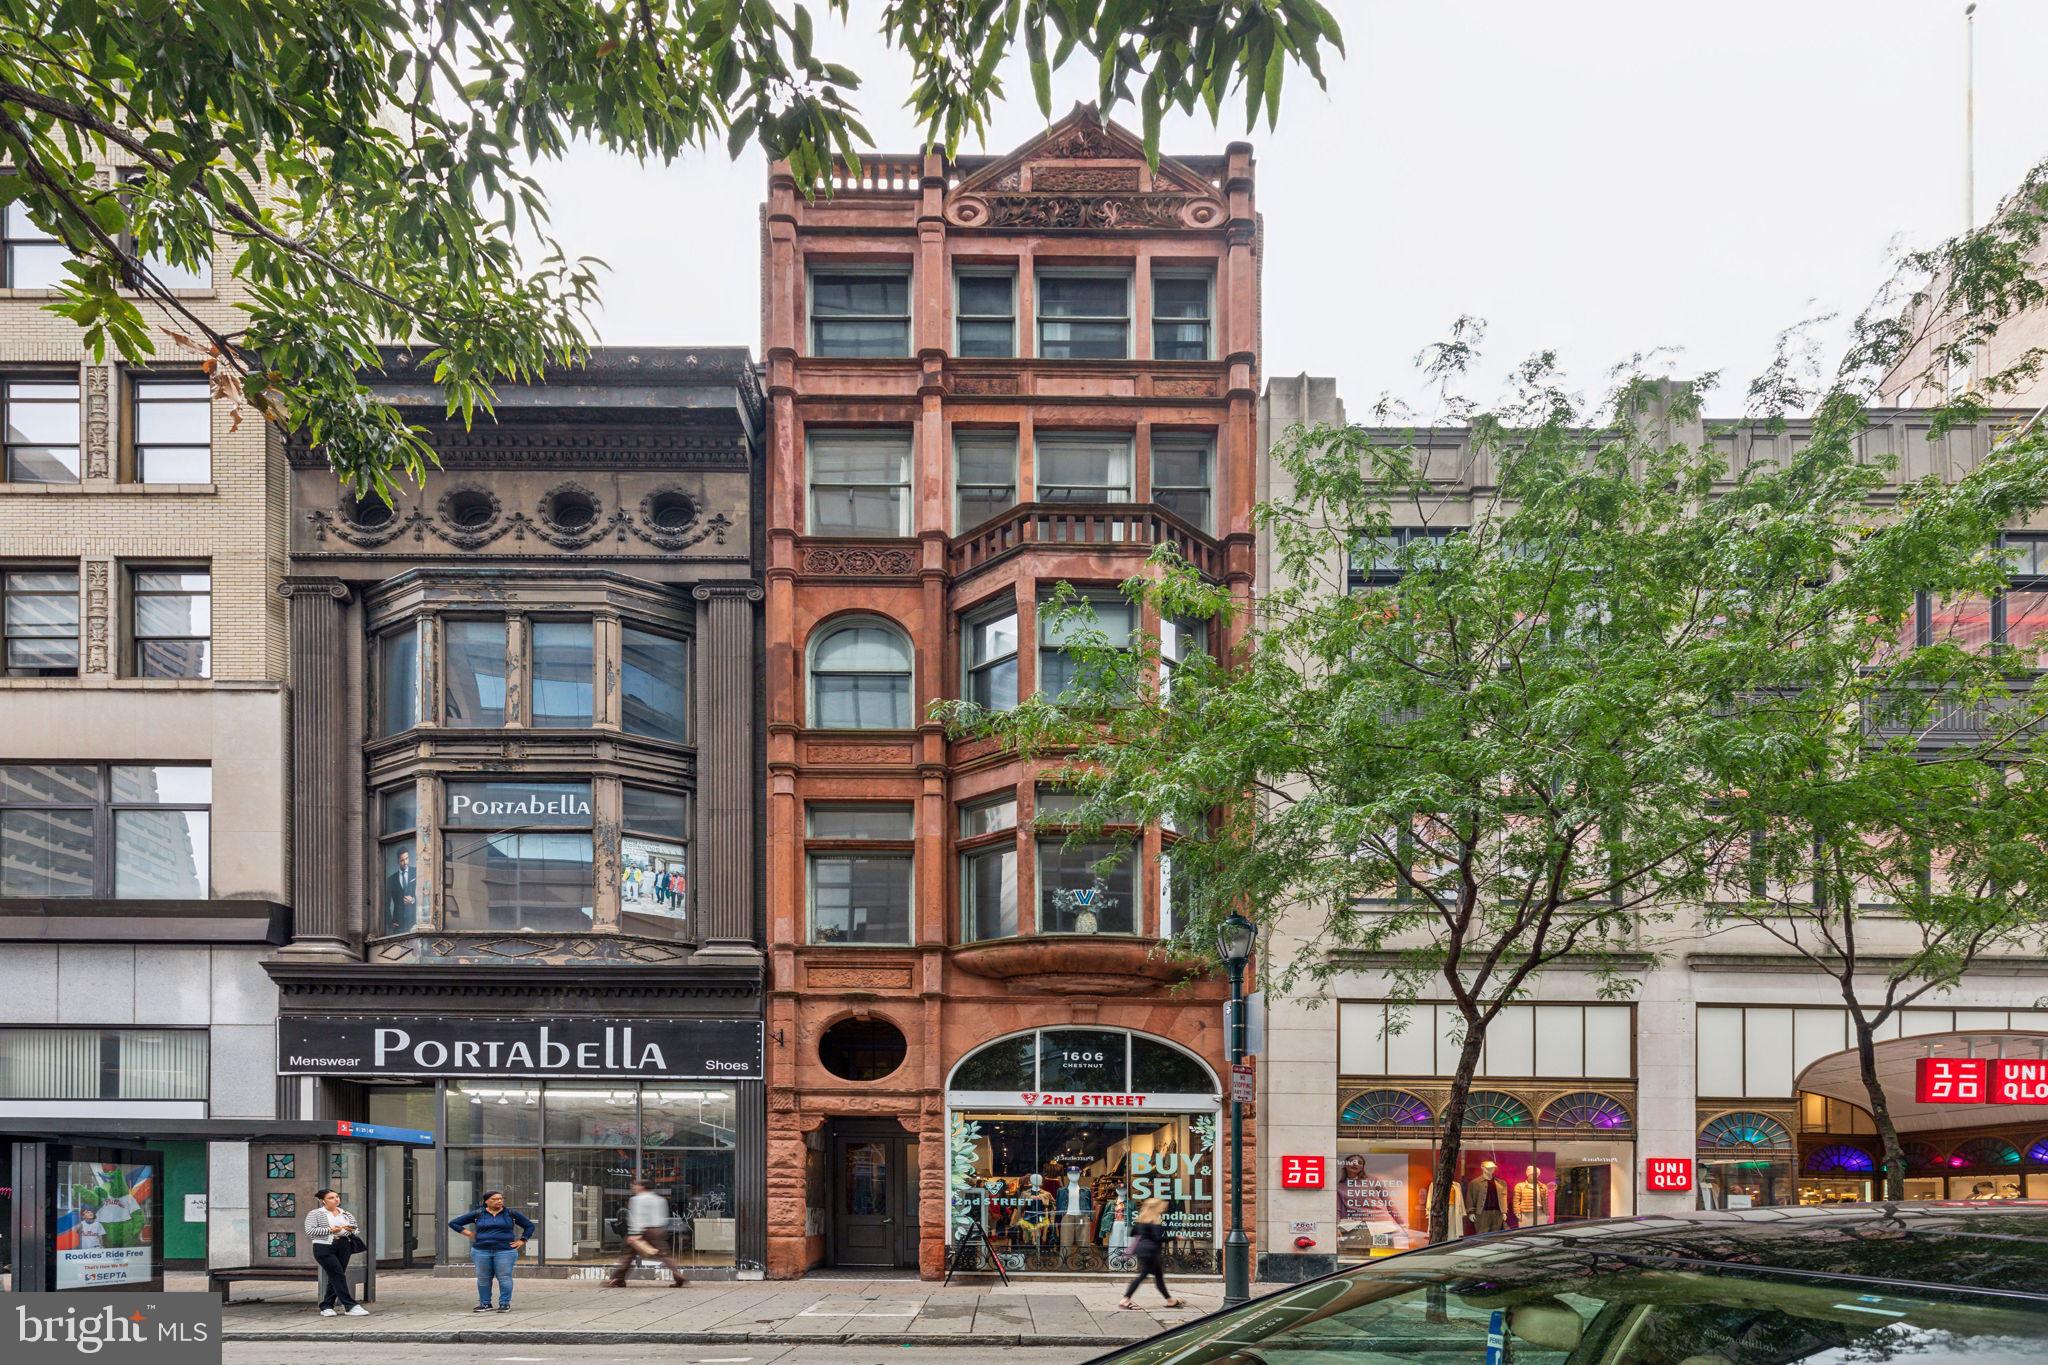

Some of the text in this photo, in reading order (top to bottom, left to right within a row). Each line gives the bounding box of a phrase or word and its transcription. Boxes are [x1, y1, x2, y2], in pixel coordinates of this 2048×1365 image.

[289, 1055, 361, 1067] Menswear
[1062, 1051, 1104, 1061] 1606
[705, 1059, 749, 1071] Shoes
[2004, 1064, 2046, 1081] UNI
[2003, 1082, 2048, 1101] QLO
[1042, 1094, 1146, 1106] 2nd STREET
[1131, 1152, 1212, 1176] BUY &
[1654, 1162, 1684, 1174] UNI
[1347, 1179, 1403, 1188] ELEVATED
[1654, 1175, 1687, 1188] QLO
[1131, 1177, 1212, 1200] SELL
[955, 1197, 1033, 1206] 2nd STREET
[1131, 1210, 1212, 1221] Sndhand
[1166, 1230, 1212, 1238] WOMEN'S
[65, 1251, 105, 1261] Rookies'
[105, 1250, 124, 1258] Ride
[96, 1271, 127, 1281] SEPTA
